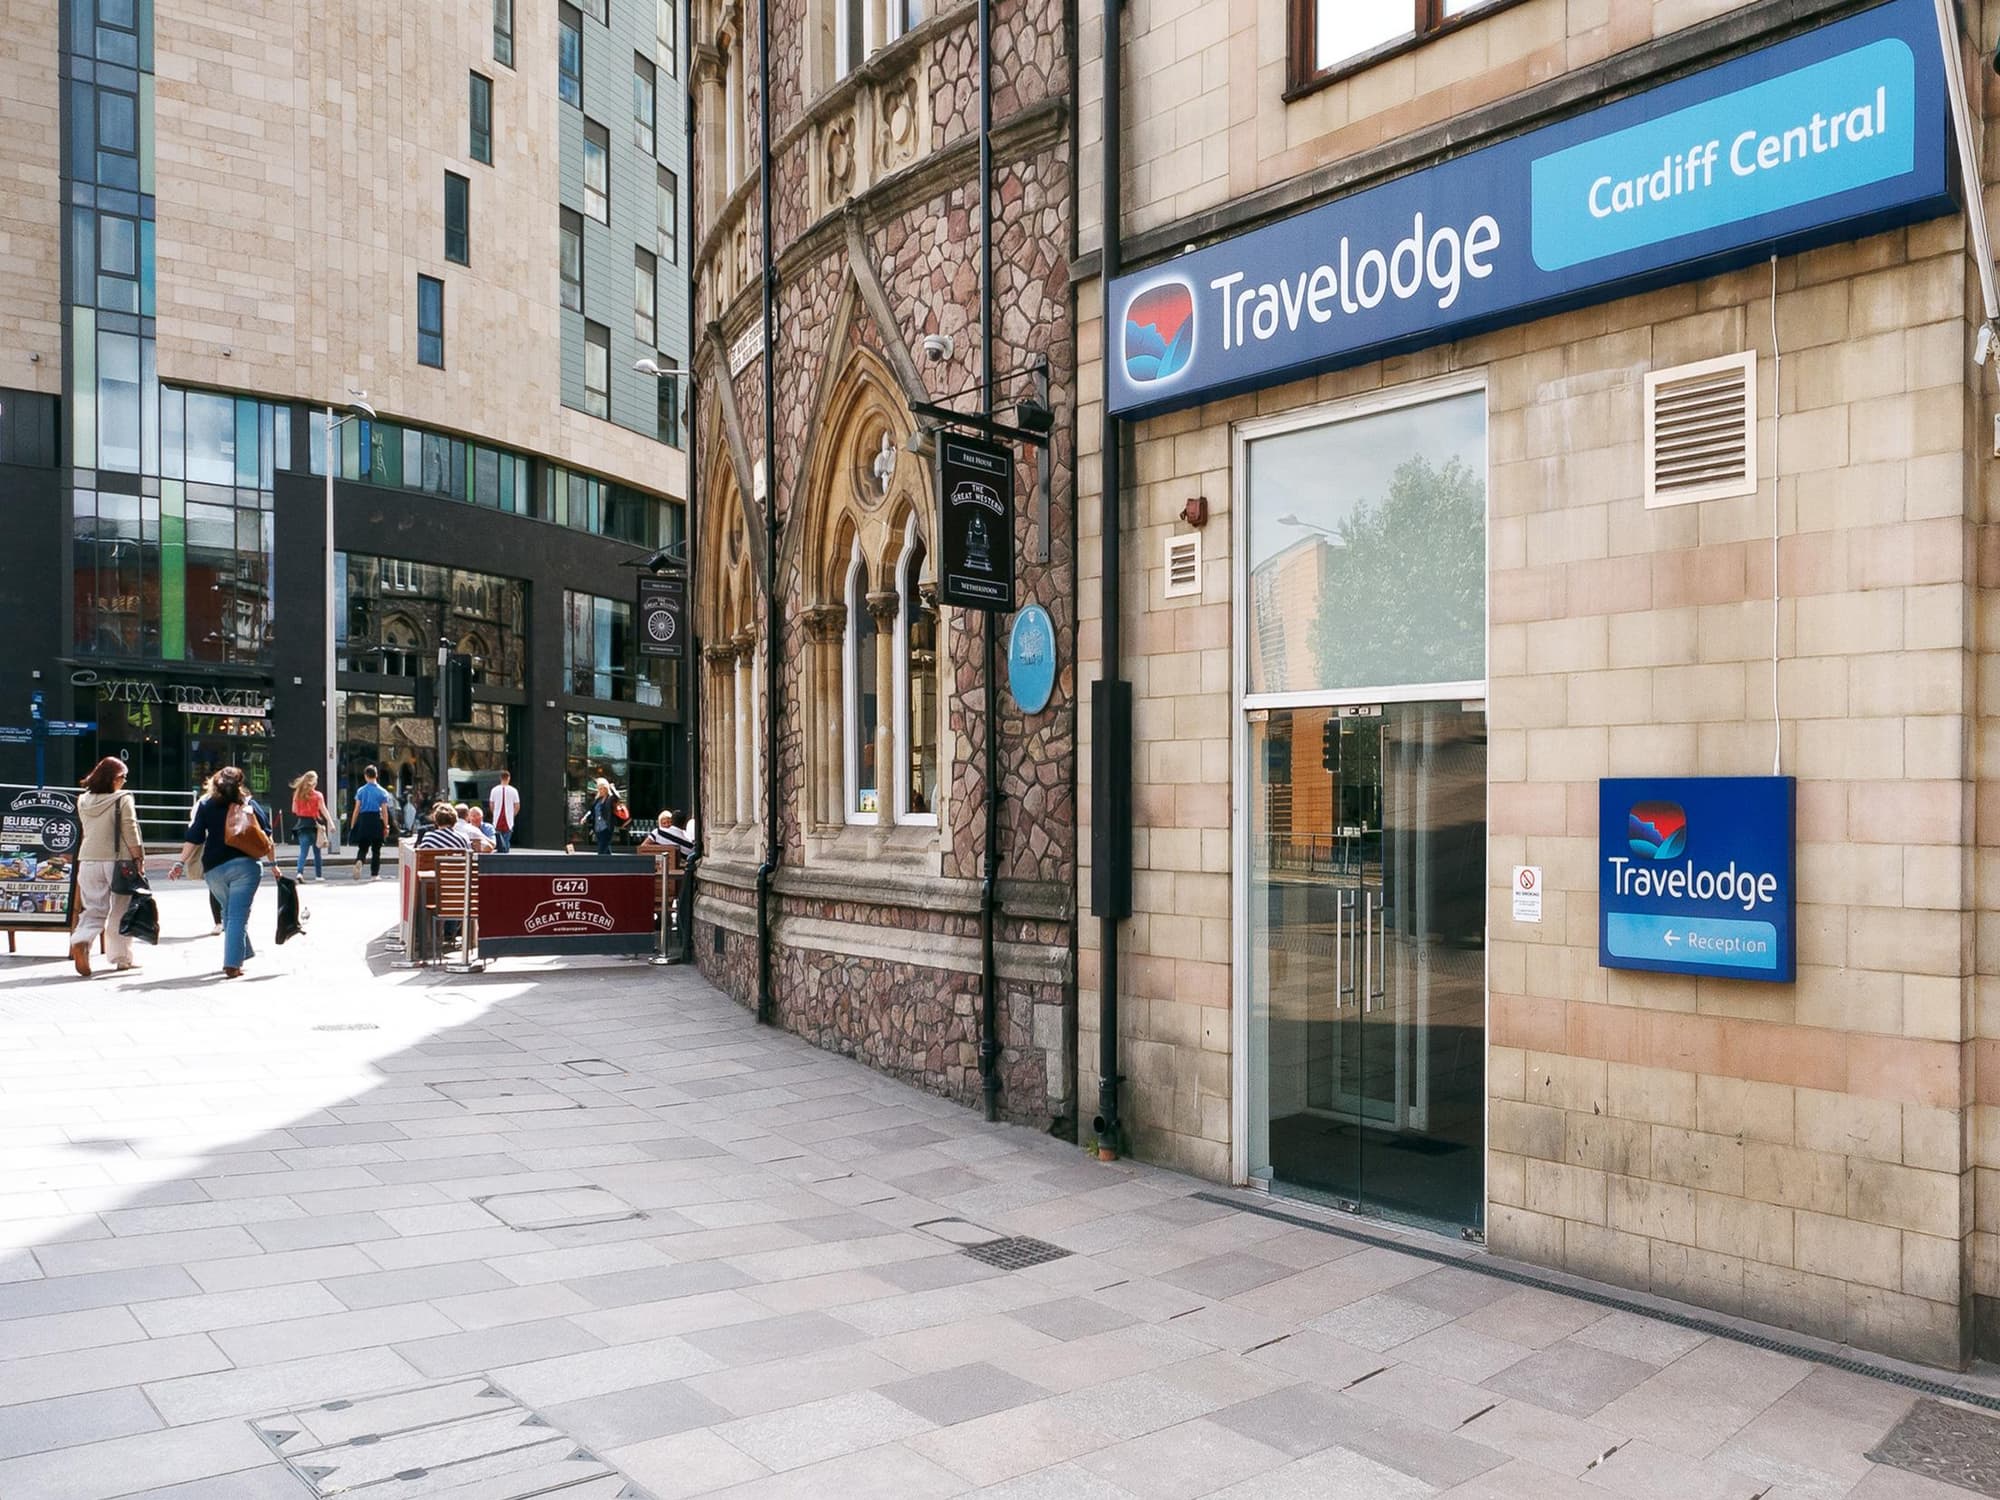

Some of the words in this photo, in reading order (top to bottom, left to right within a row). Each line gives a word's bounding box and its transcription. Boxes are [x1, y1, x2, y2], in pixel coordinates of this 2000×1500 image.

[1588, 140, 1720, 218] Cardiff
[1730, 86, 1886, 177] Central
[1210, 211, 1501, 351] Travelodge
[972, 484, 984, 494] THE
[953, 492, 972, 503] GREAT
[975, 493, 1003, 513] WESTERN
[104, 681, 163, 704] VIVA
[168, 684, 265, 707] BRAZIL
[13, 798, 37, 809] GREAT
[40, 799, 73, 811] WESTERN
[3, 815, 20, 826] DELI
[556, 881, 585, 892] 6474
[1608, 857, 1778, 911] Travelodge
[560, 901, 581, 910] THE
[527, 912, 561, 930] GREAT
[566, 911, 612, 928] WESTERN
[1688, 931, 1768, 954] Reception
